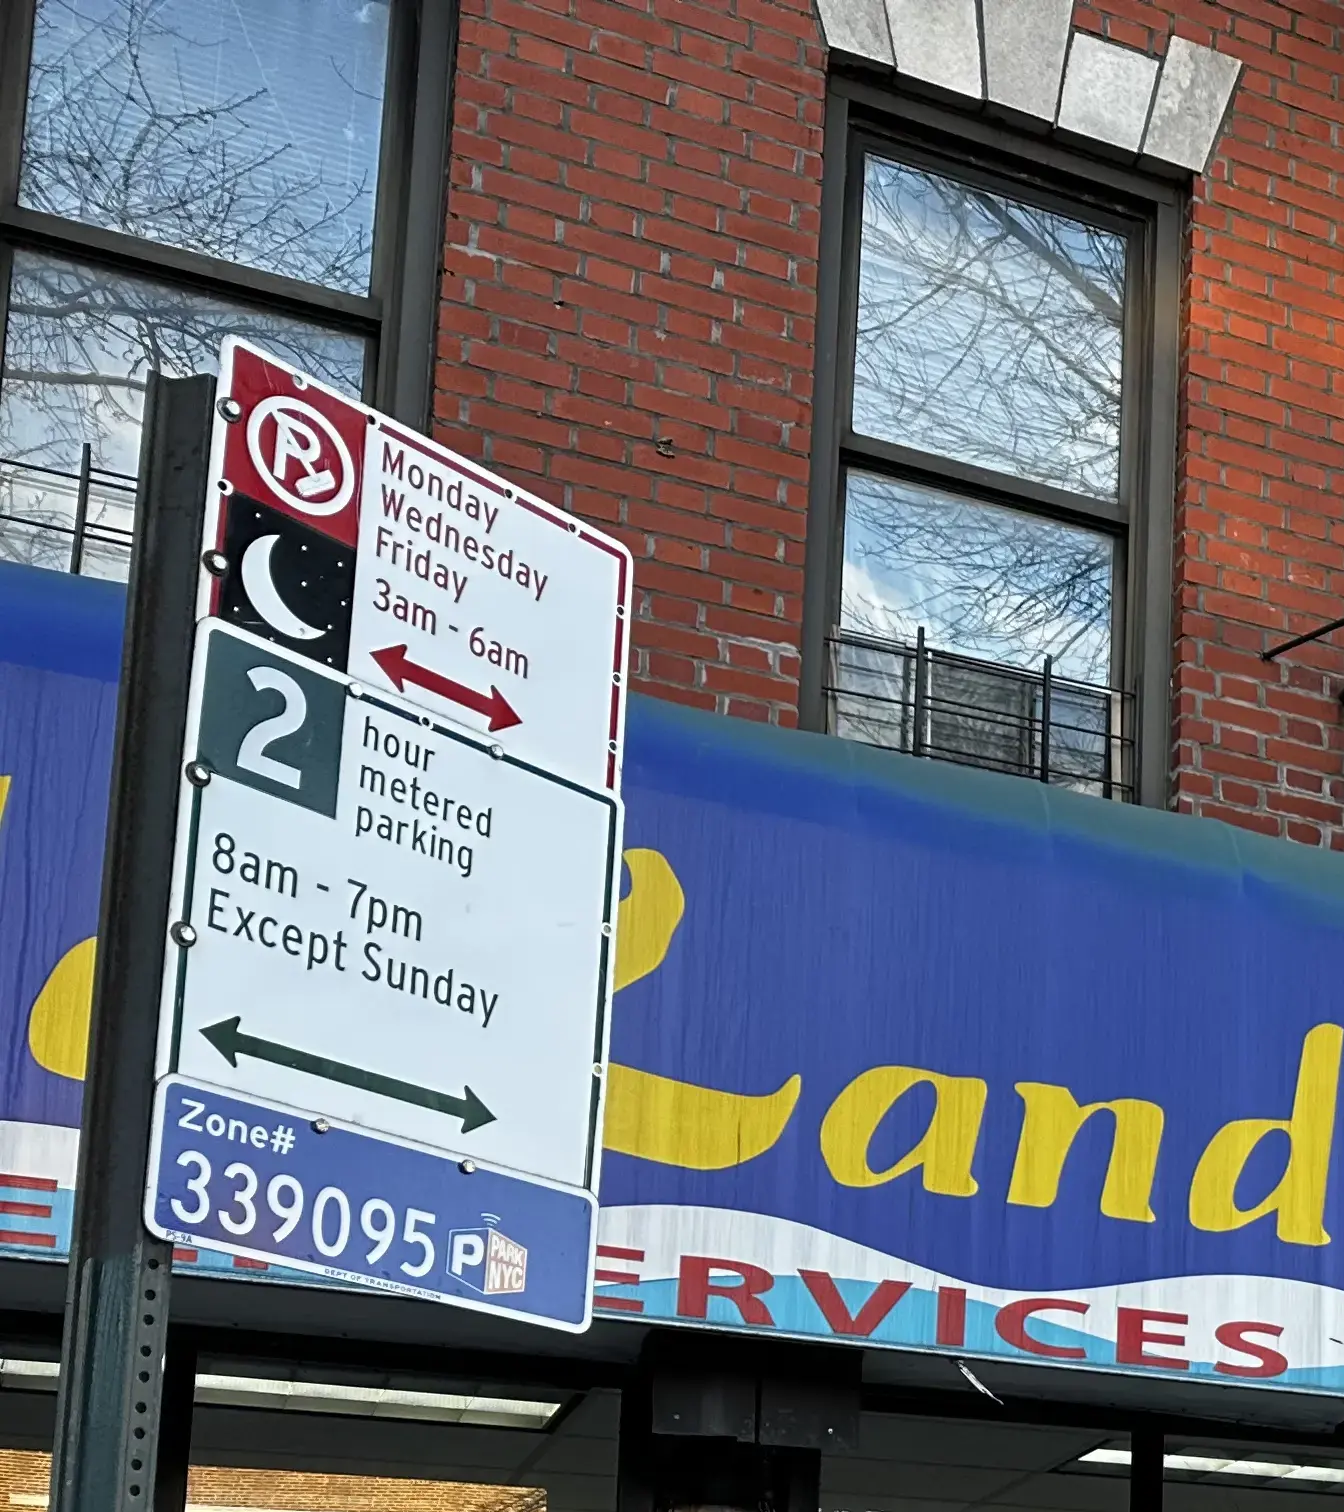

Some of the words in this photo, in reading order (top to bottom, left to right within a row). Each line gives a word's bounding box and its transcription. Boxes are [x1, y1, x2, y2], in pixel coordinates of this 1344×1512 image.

[382, 441, 499, 534] Monday
[375, 526, 468, 603] Friday
[381, 484, 548, 601] Wednesday
[372, 578, 437, 635] 3am
[469, 627, 529, 679] 6am
[236, 665, 307, 790] 2
[362, 716, 435, 771] hour
[355, 805, 473, 878] parking
[360, 764, 492, 838] metered
[212, 833, 298, 898] 8am
[347, 878, 423, 941] 7pm
[207, 887, 347, 971] Except
[361, 941, 499, 1028] Sunday
[177, 1098, 296, 1156] Zone#
[171, 1149, 437, 1279] 339095
[490, 1237, 526, 1266] PARK
[324, 1268, 345, 1279] DEPT
[350, 1273, 363, 1282] OF
[488, 1260, 526, 1293] NYC
[597, 1245, 1288, 1379] ERVICES
